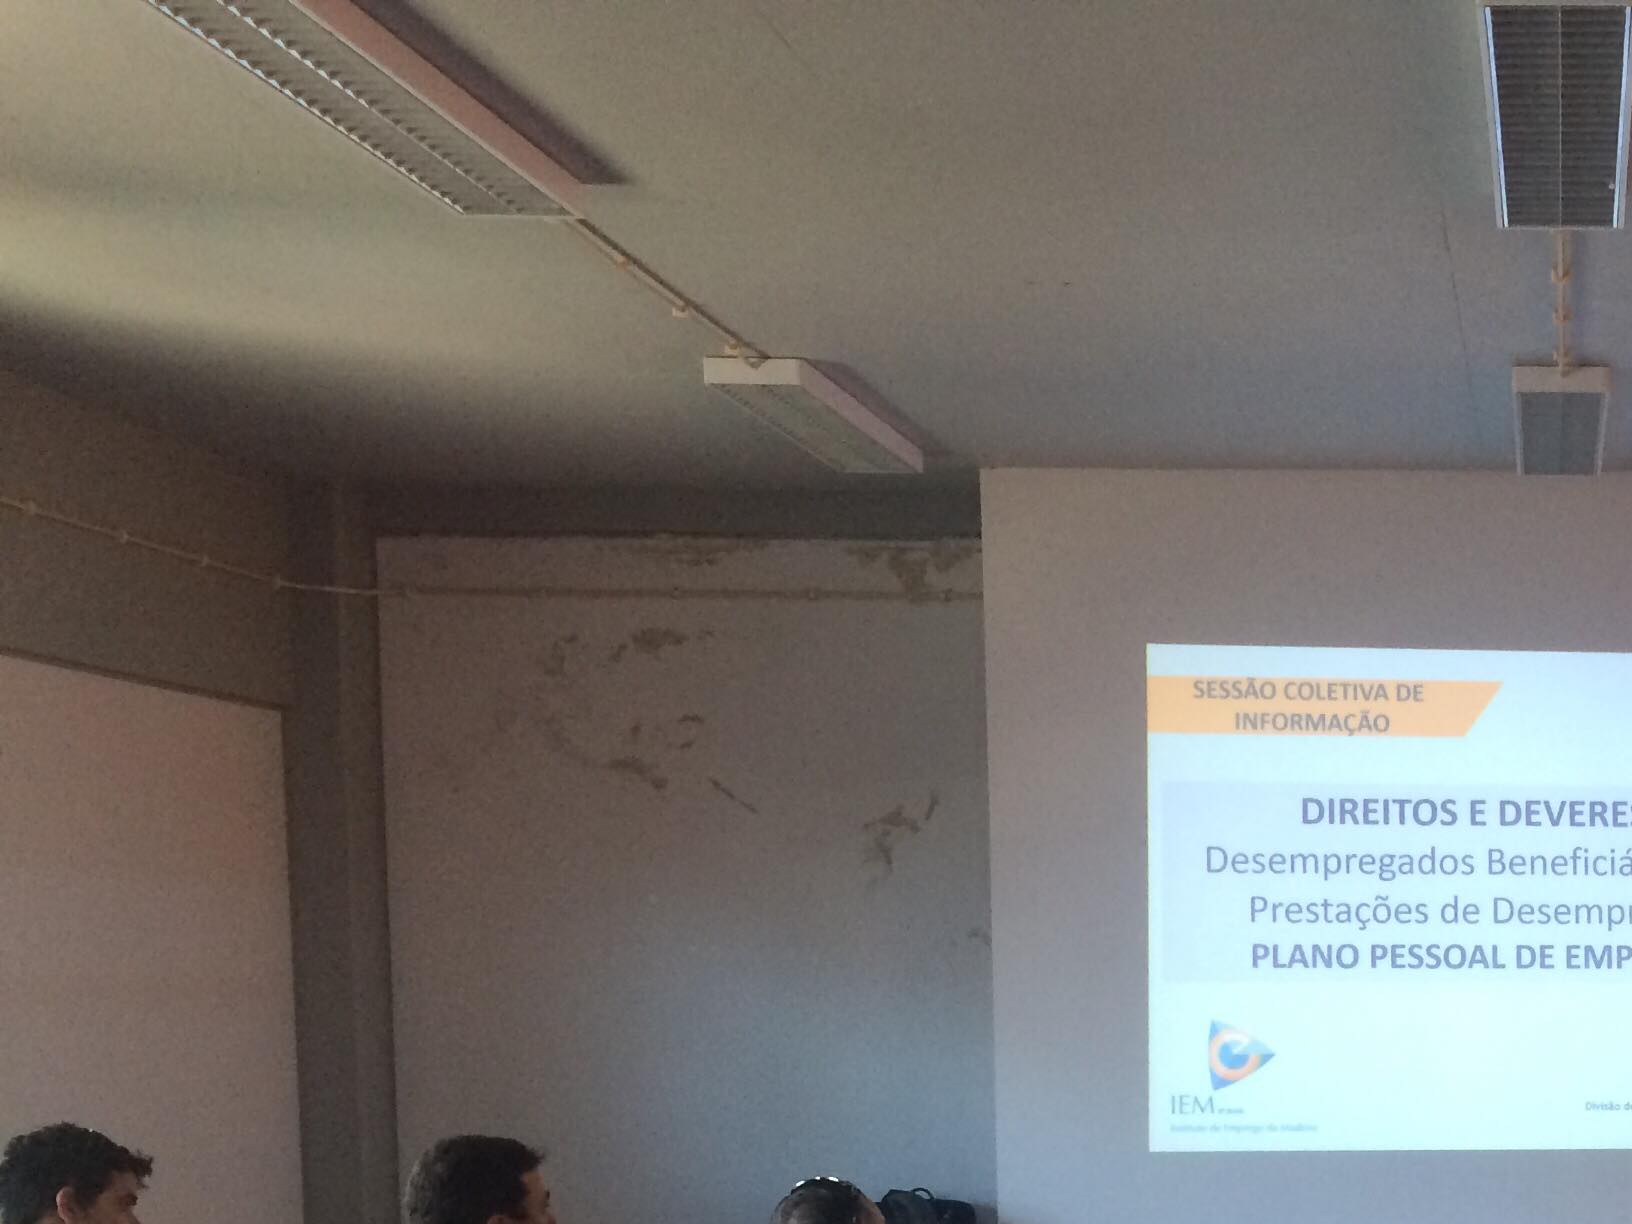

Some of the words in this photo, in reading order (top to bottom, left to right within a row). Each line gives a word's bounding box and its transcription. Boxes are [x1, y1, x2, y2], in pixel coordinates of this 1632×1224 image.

[1193, 678, 1277, 701] SESSÃO
[1283, 682, 1389, 702] COLETIVA
[1396, 684, 1424, 703] DE
[1234, 710, 1391, 736] INFORMAÇÃO
[1301, 797, 1459, 827] DIREITOS
[1469, 799, 1488, 827] E
[1205, 845, 1475, 882] Desempregados
[1250, 894, 1429, 931] Prestações
[1440, 895, 1481, 925] de
[1251, 942, 1361, 970] PLANO
[1370, 943, 1507, 970] PESSOAL
[1515, 944, 1555, 970] DE
[1170, 1094, 1215, 1115] IEM
